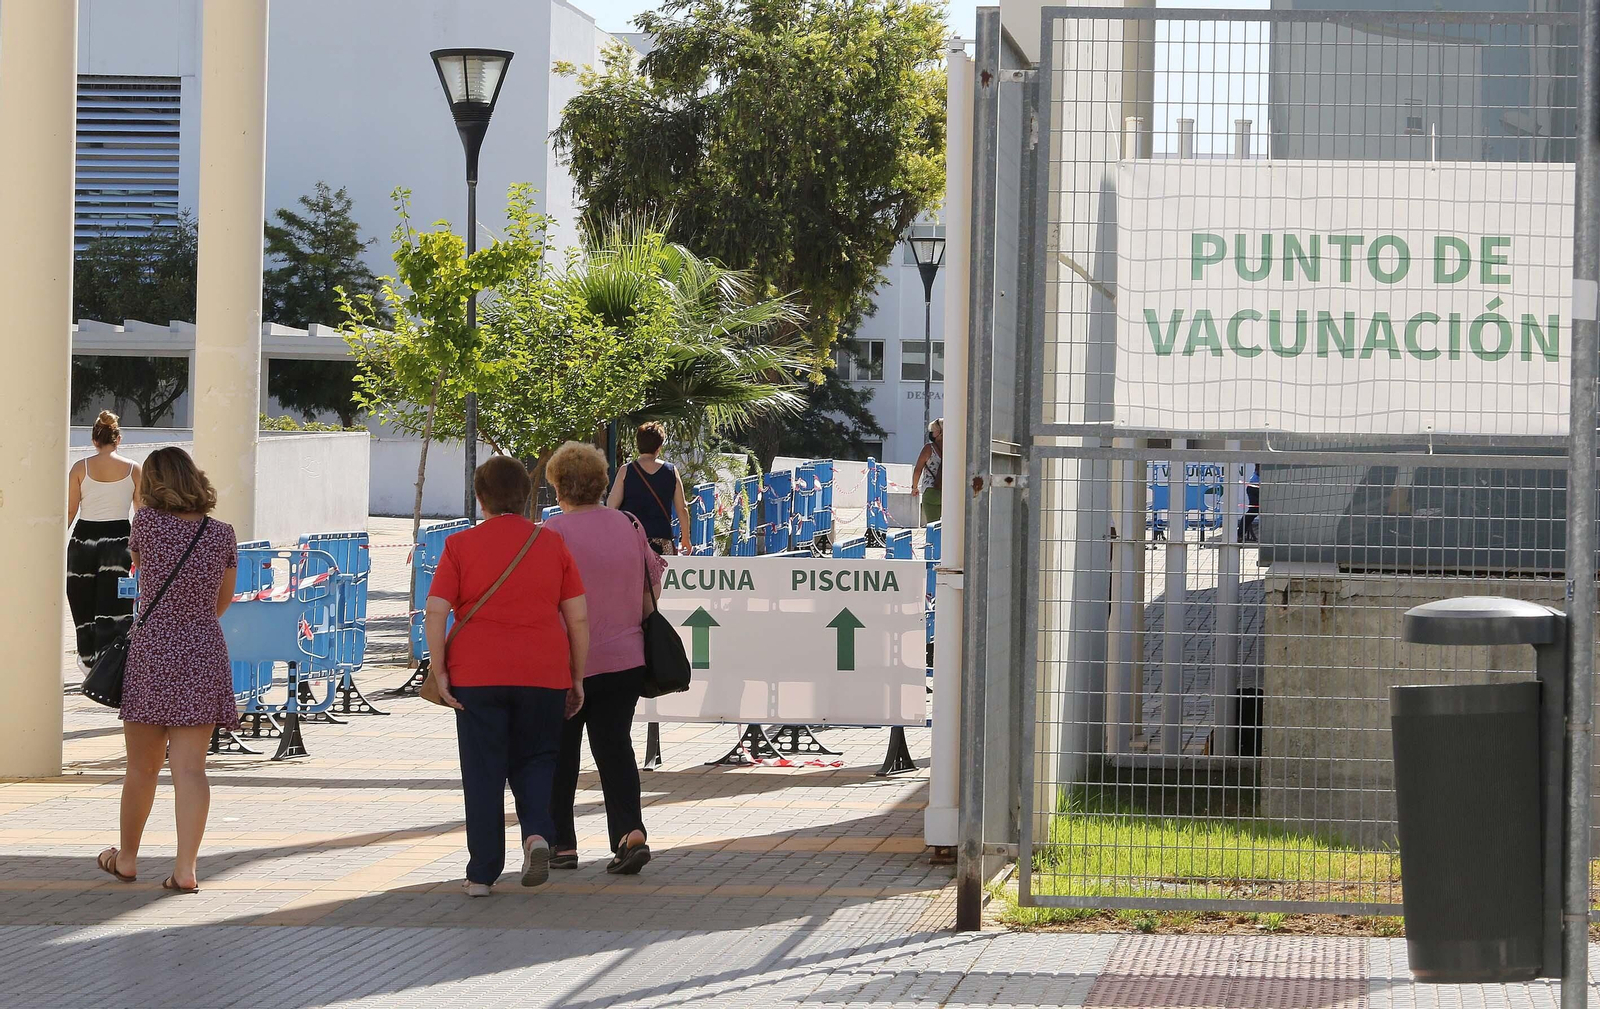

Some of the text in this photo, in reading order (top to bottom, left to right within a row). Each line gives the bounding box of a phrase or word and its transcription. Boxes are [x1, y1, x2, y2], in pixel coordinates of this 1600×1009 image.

[1190, 233, 1512, 285] PUNTO DE
[1143, 296, 1560, 363] VACUNACIÓN
[907, 390, 945, 400] DESPA
[662, 568, 900, 592] ACUNA PISCINA
